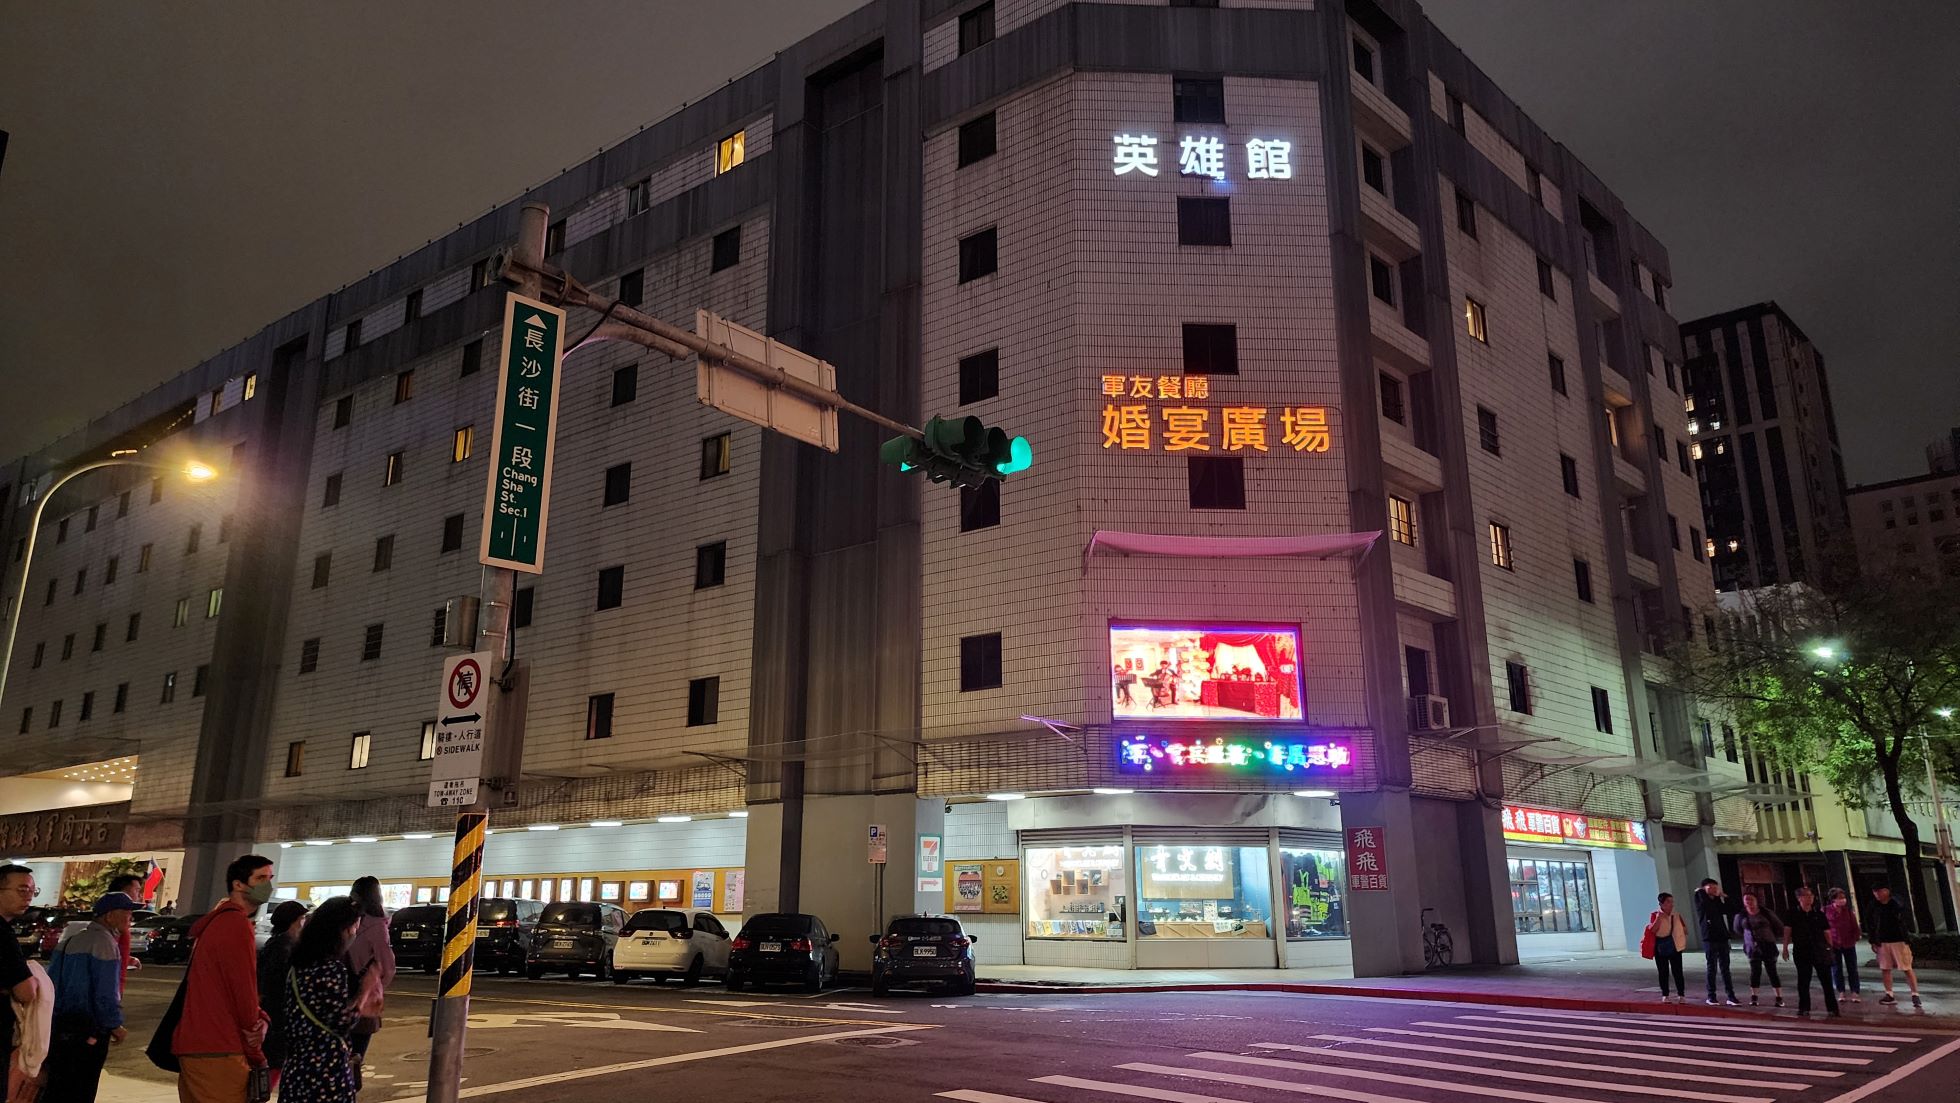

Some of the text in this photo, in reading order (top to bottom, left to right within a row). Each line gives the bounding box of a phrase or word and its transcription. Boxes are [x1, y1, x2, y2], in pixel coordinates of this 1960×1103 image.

[1113, 134, 1292, 180] 英雄館
[1101, 374, 1209, 399] 軍友餐廳
[512, 328, 545, 470] 長沙街一段
[1102, 404, 1330, 453] 婚宴廣場
[502, 467, 538, 487] Chang
[501, 479, 524, 493] Sha
[500, 491, 517, 504] St.
[443, 743, 481, 756] SIDEWALK
[459, 787, 473, 796] ZONE
[452, 796, 464, 805] 110
[1351, 874, 1388, 889] 軍警百貨
